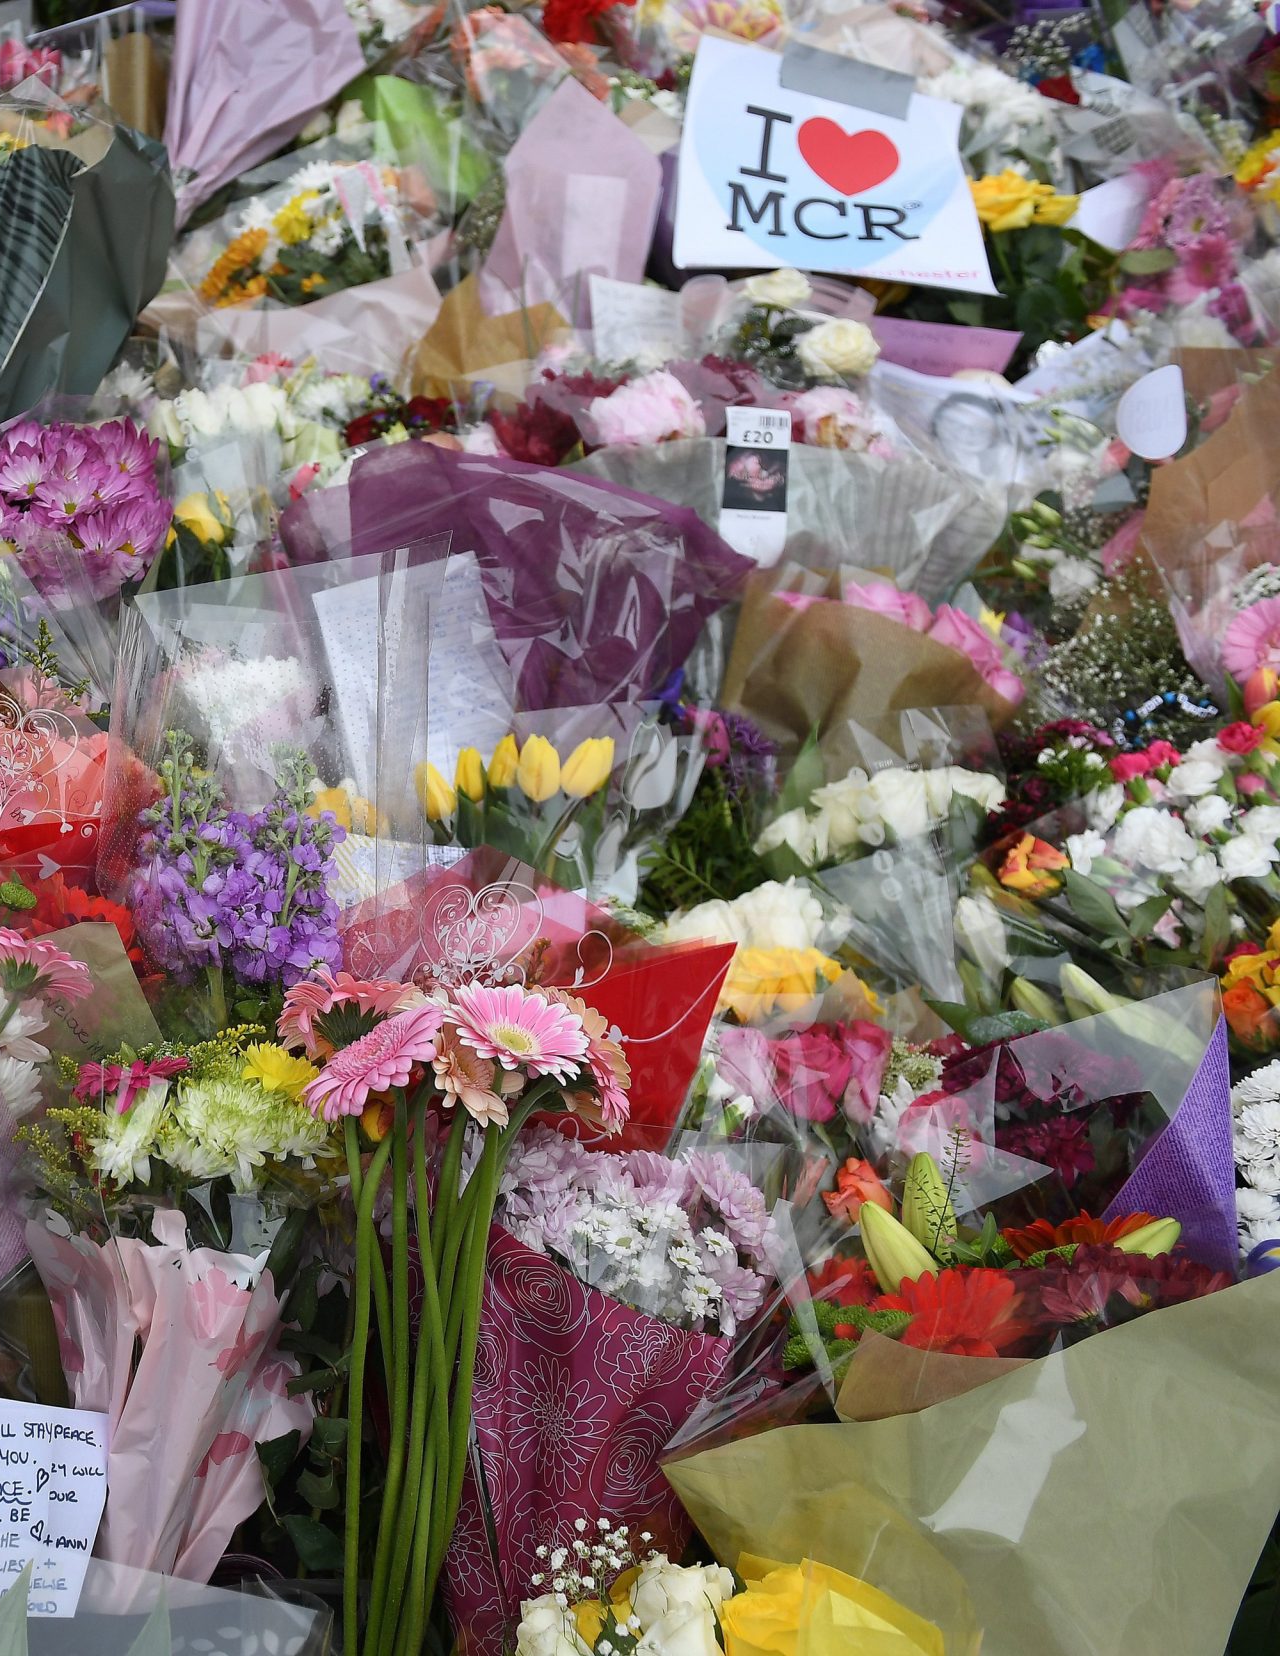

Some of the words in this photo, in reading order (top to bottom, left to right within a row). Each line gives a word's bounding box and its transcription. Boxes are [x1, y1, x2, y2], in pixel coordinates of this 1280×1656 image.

[740, 104, 793, 184] I
[725, 180, 921, 241] MCR
[742, 430, 774, 445] £20
[23, 1422, 53, 1444] STAY
[72, 1465, 105, 1477] WILL
[9, 1508, 31, 1523] BE
